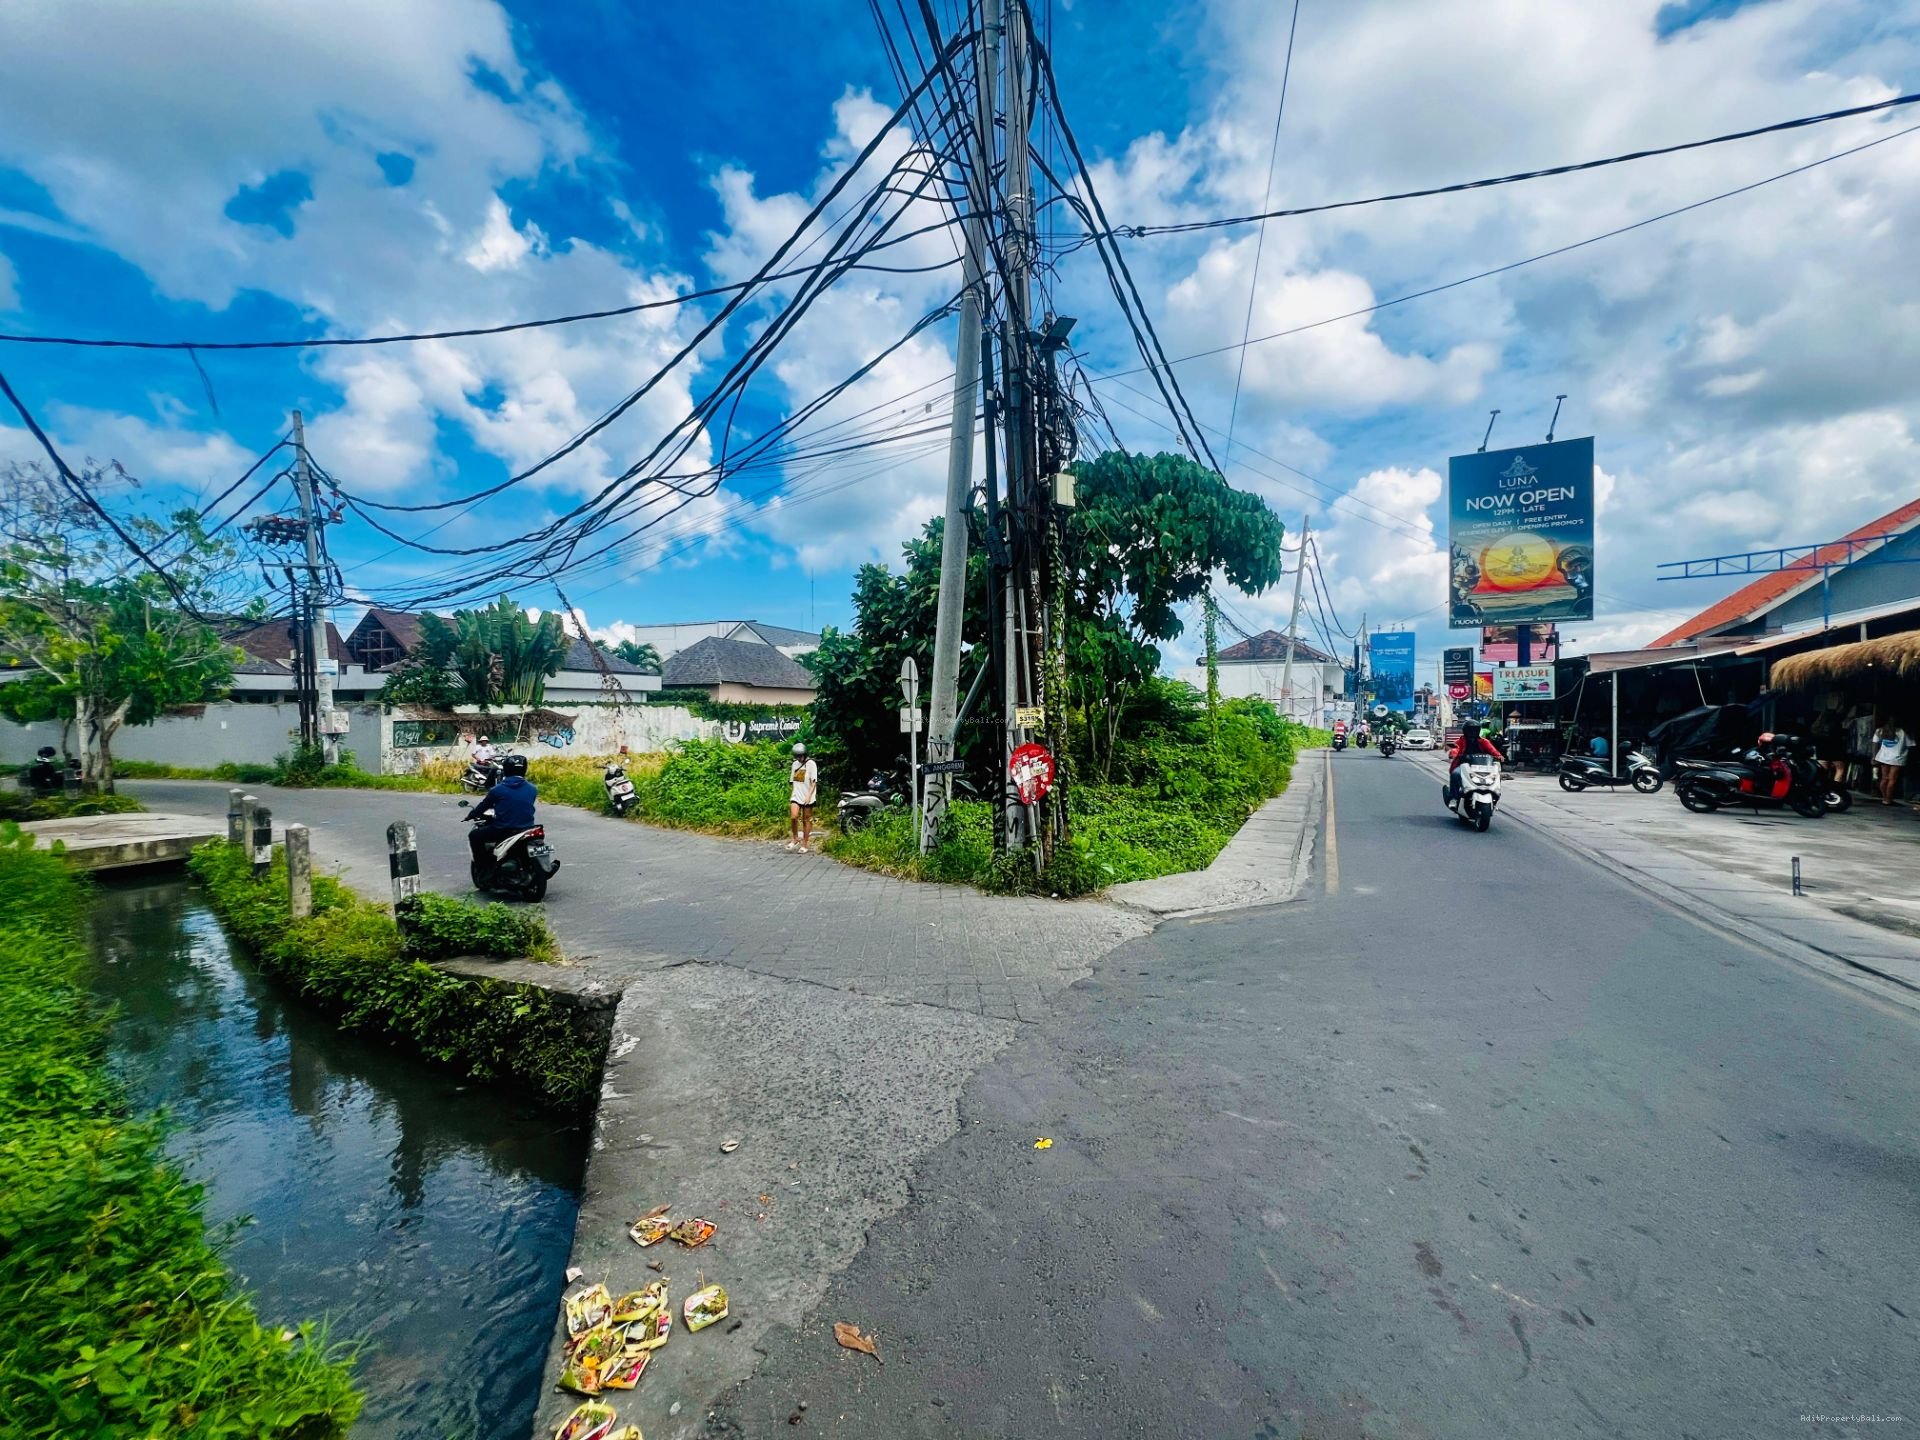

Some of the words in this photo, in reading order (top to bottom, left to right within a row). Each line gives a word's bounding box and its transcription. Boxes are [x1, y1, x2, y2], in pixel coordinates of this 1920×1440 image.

[1499, 475, 1539, 488] LUNA
[1466, 493, 1515, 511] NOW
[1519, 486, 1575, 505] OPEN
[1493, 508, 1515, 516] 12PM
[1522, 504, 1545, 513] LATE
[1524, 516, 1543, 524] FREE
[1544, 513, 1568, 522] ENTRY
[1517, 523, 1550, 531] OPENING
[1499, 669, 1550, 679] TREASURE
[749, 720, 778, 734] Supreme
